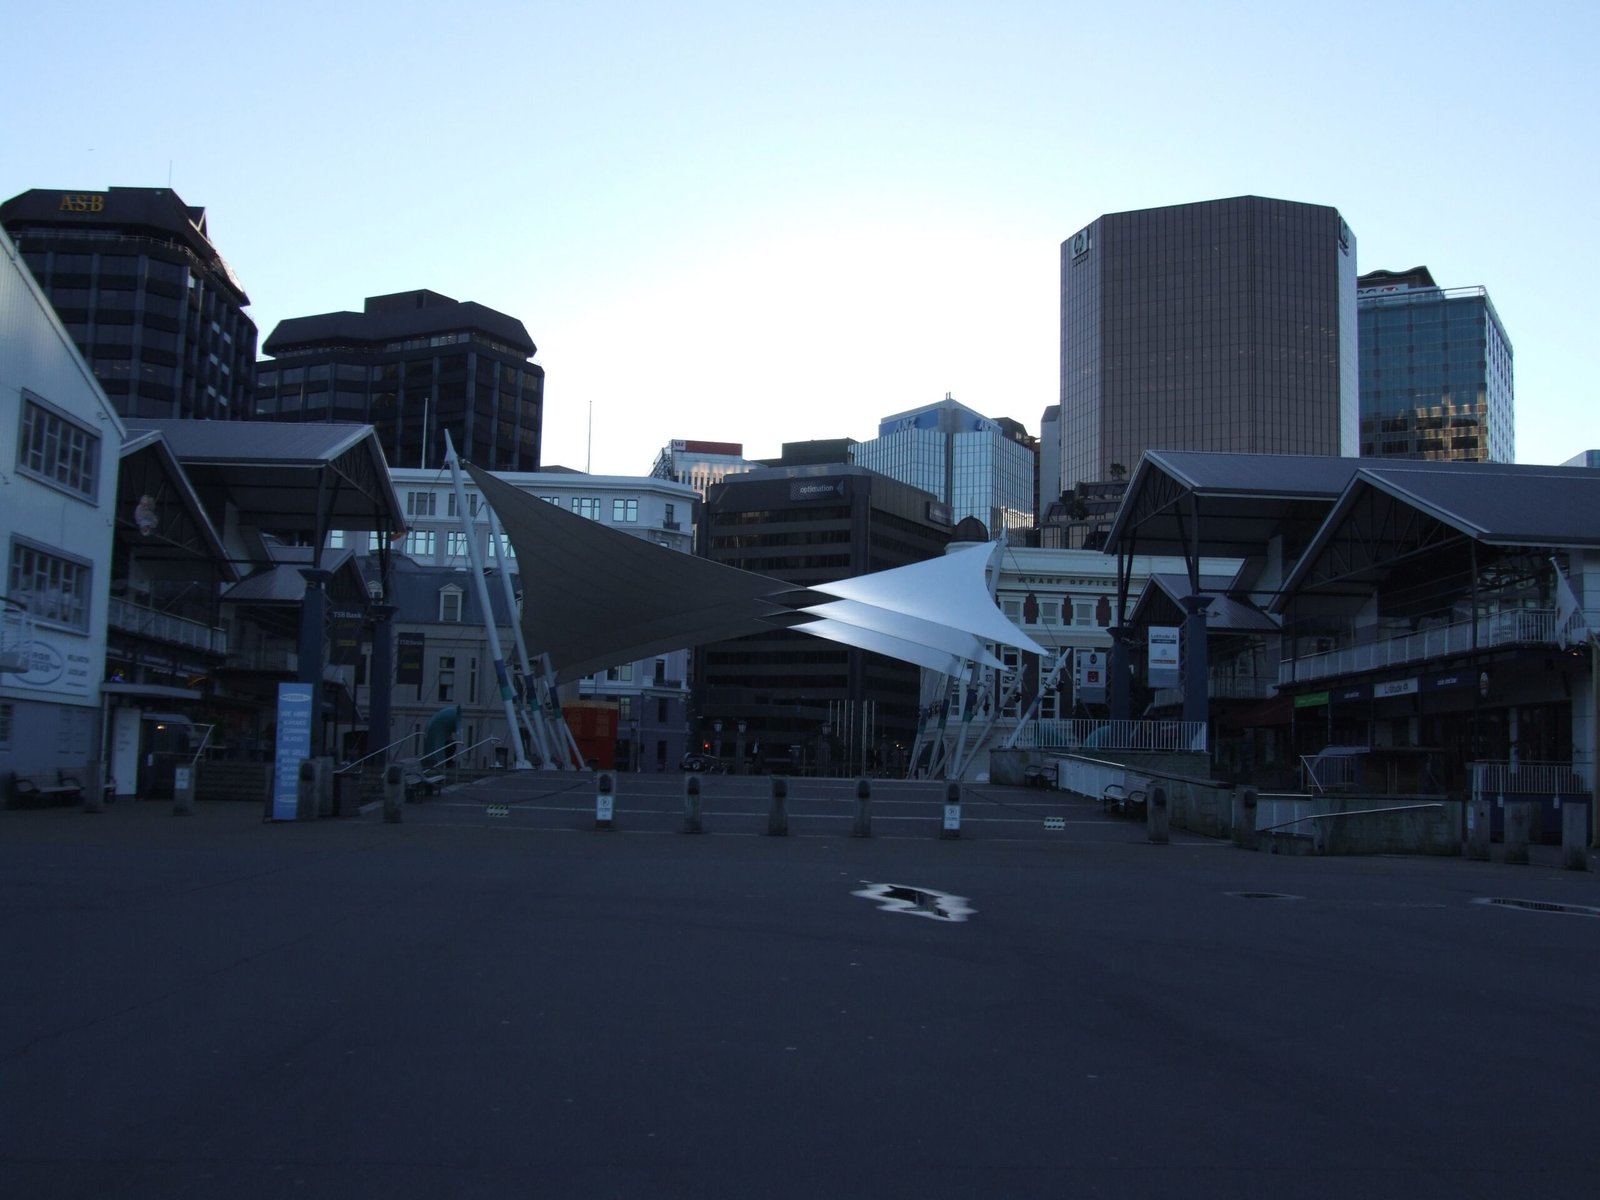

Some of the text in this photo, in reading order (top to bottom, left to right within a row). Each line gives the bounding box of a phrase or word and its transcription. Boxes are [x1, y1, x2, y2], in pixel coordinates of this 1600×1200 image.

[59, 194, 104, 212] ASB
[894, 416, 917, 432] ANZ
[800, 485, 834, 494] optimation
[1017, 576, 1063, 586] WHARF
[346, 611, 362, 619] Bank
